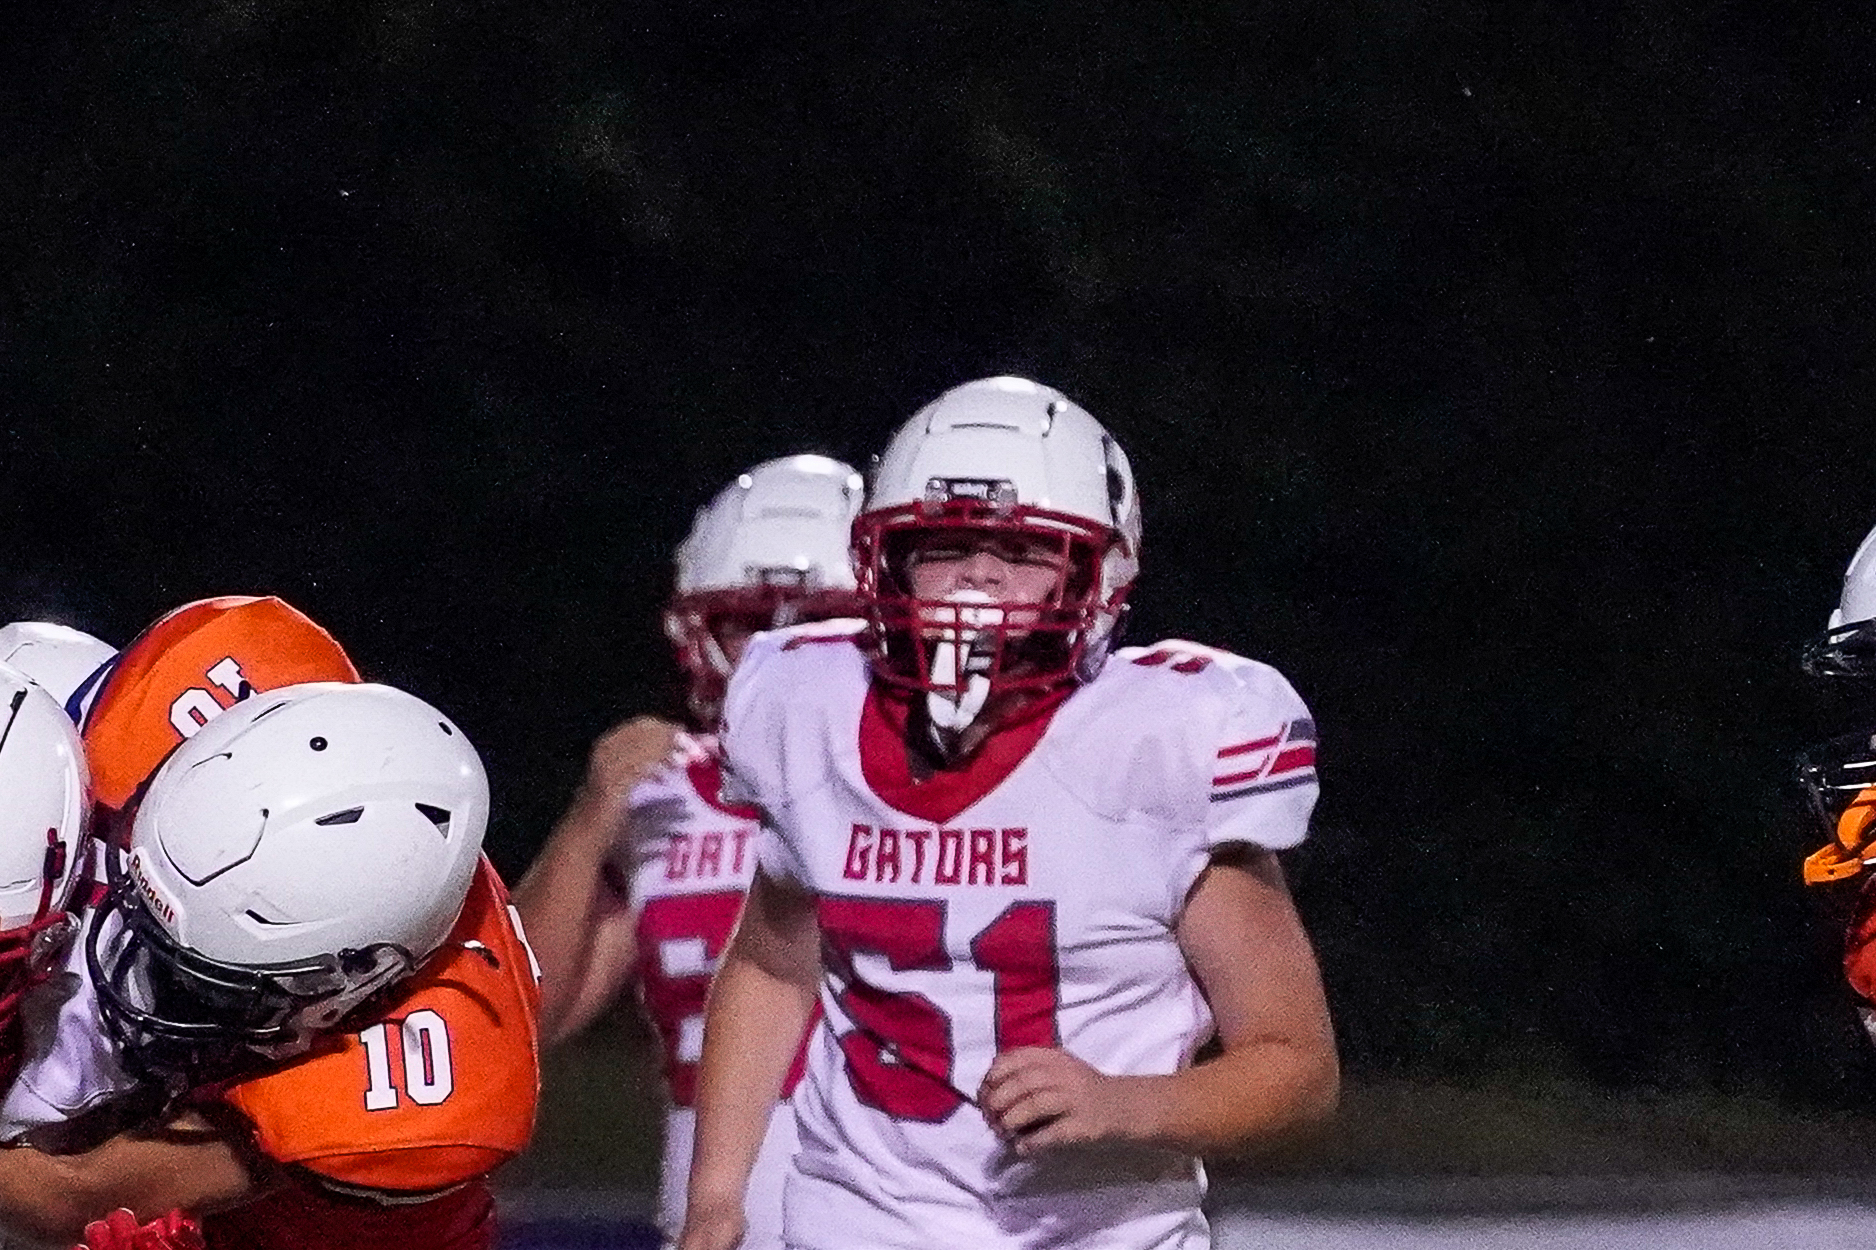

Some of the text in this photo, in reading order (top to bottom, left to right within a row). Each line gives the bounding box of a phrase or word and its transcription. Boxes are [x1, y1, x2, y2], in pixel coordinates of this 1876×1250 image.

[843, 825, 1027, 885] GATORS
[361, 1010, 454, 1111] 10
[817, 898, 1060, 1123] 51
